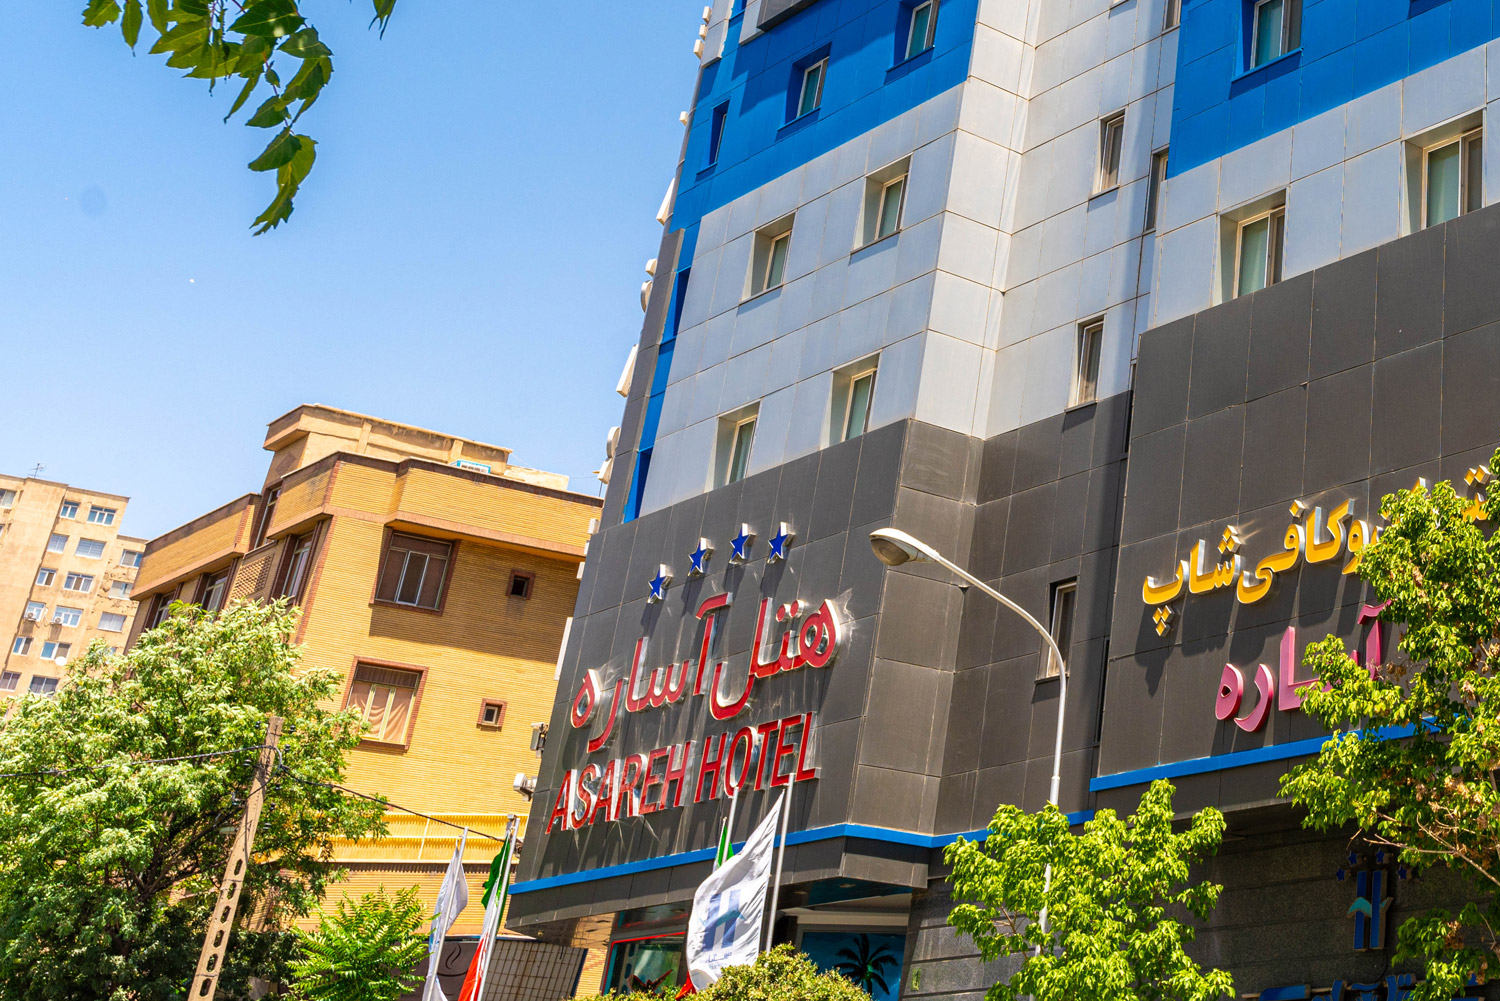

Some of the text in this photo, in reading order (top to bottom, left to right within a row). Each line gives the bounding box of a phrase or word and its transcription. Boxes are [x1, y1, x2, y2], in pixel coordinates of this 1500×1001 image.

[570, 591, 843, 754] هتل آساره
[1214, 597, 1393, 733] آاره
[544, 710, 818, 836] ASAREH HOTEL
